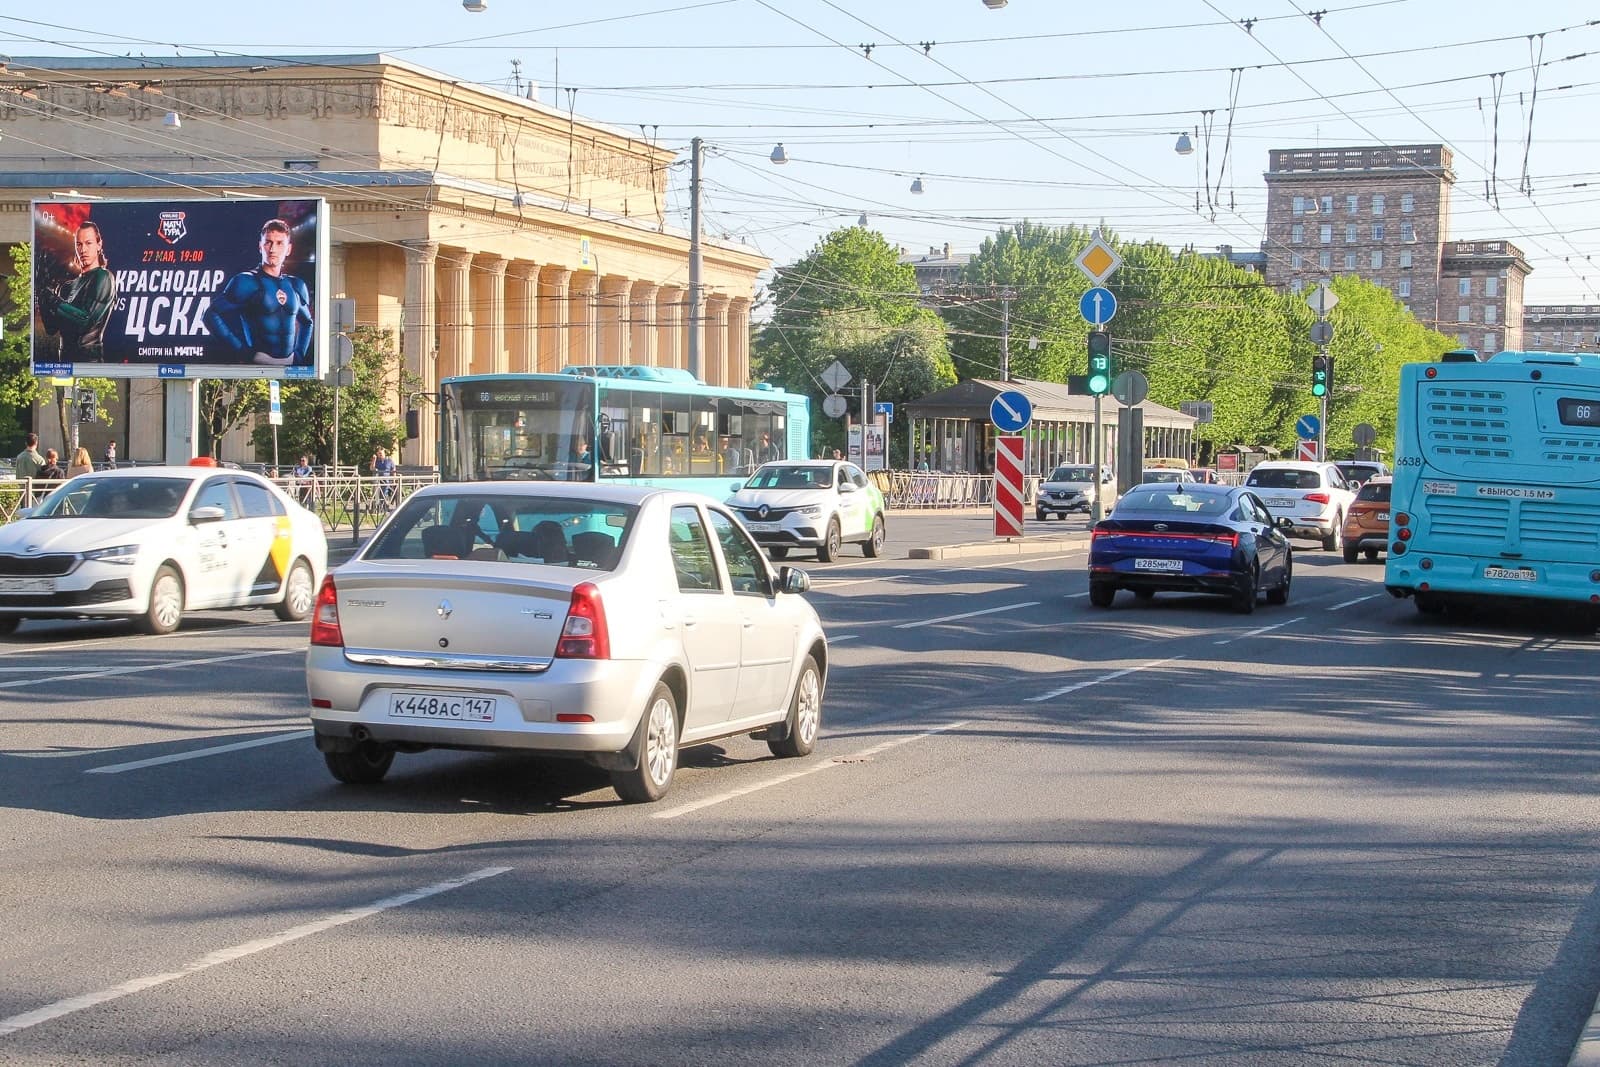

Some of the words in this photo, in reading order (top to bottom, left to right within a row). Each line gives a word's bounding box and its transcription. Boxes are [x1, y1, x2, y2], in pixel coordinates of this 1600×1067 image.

[43, 210, 55, 222] 0+
[163, 220, 182, 229] МАТЧ
[164, 228, 180, 236] ТУРА
[142, 250, 154, 262] 27
[155, 250, 176, 263] МАЯ,
[180, 250, 204, 262] 19:00
[115, 270, 225, 296] КРАСНОДАР
[125, 296, 211, 342] ЦСКА
[138, 347, 163, 356] СМОТРИ
[164, 347, 173, 356] НА
[174, 346, 204, 356] МАТЧ!
[1093, 357, 1107, 370] 13
[167, 367, 183, 375] Russ
[1577, 405, 1591, 419] 66
[1397, 456, 1421, 467] 6638
[1487, 487, 1521, 497] ВЫНОС
[1537, 490, 1545, 498] М
[394, 697, 461, 716] К448АС
[465, 700, 491, 714] 147
